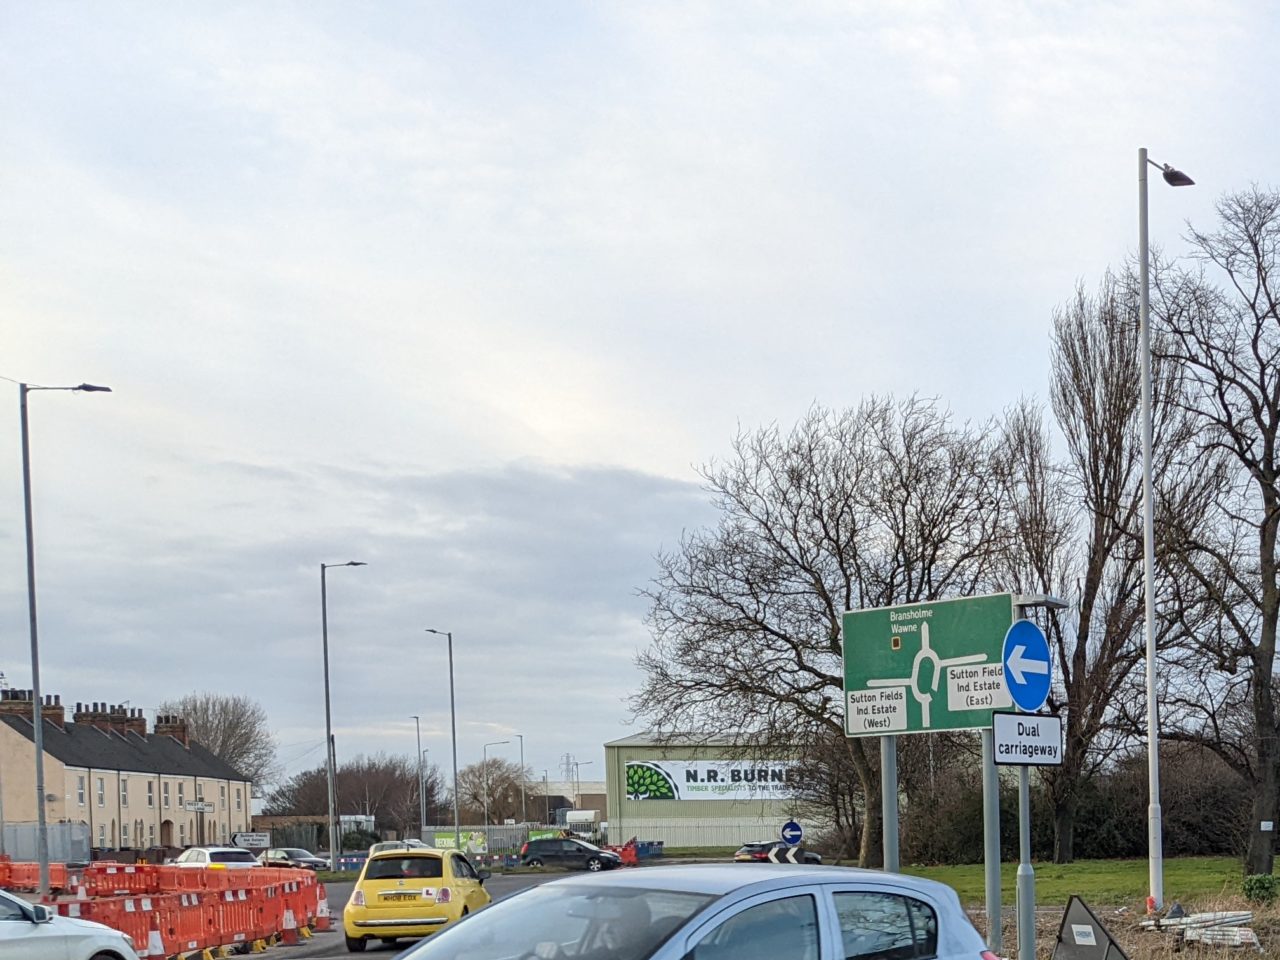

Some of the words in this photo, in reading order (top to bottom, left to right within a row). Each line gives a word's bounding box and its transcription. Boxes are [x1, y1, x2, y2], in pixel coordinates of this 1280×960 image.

[890, 609, 933, 621] Bransholme
[891, 624, 918, 633] Wawne
[950, 669, 979, 680] Sutton
[982, 666, 1003, 677] Field
[957, 682, 971, 693] Ind.
[973, 681, 1001, 692] Estate
[850, 694, 877, 704] Sutton
[880, 691, 903, 701] Fields
[965, 693, 993, 707] (East)
[856, 706, 871, 716] Ind.
[871, 704, 897, 715] Estate
[863, 716, 891, 730] (West)
[1017, 722, 1041, 737] Dual
[998, 741, 1058, 759] carriageway
[685, 769, 726, 783] N.R.
